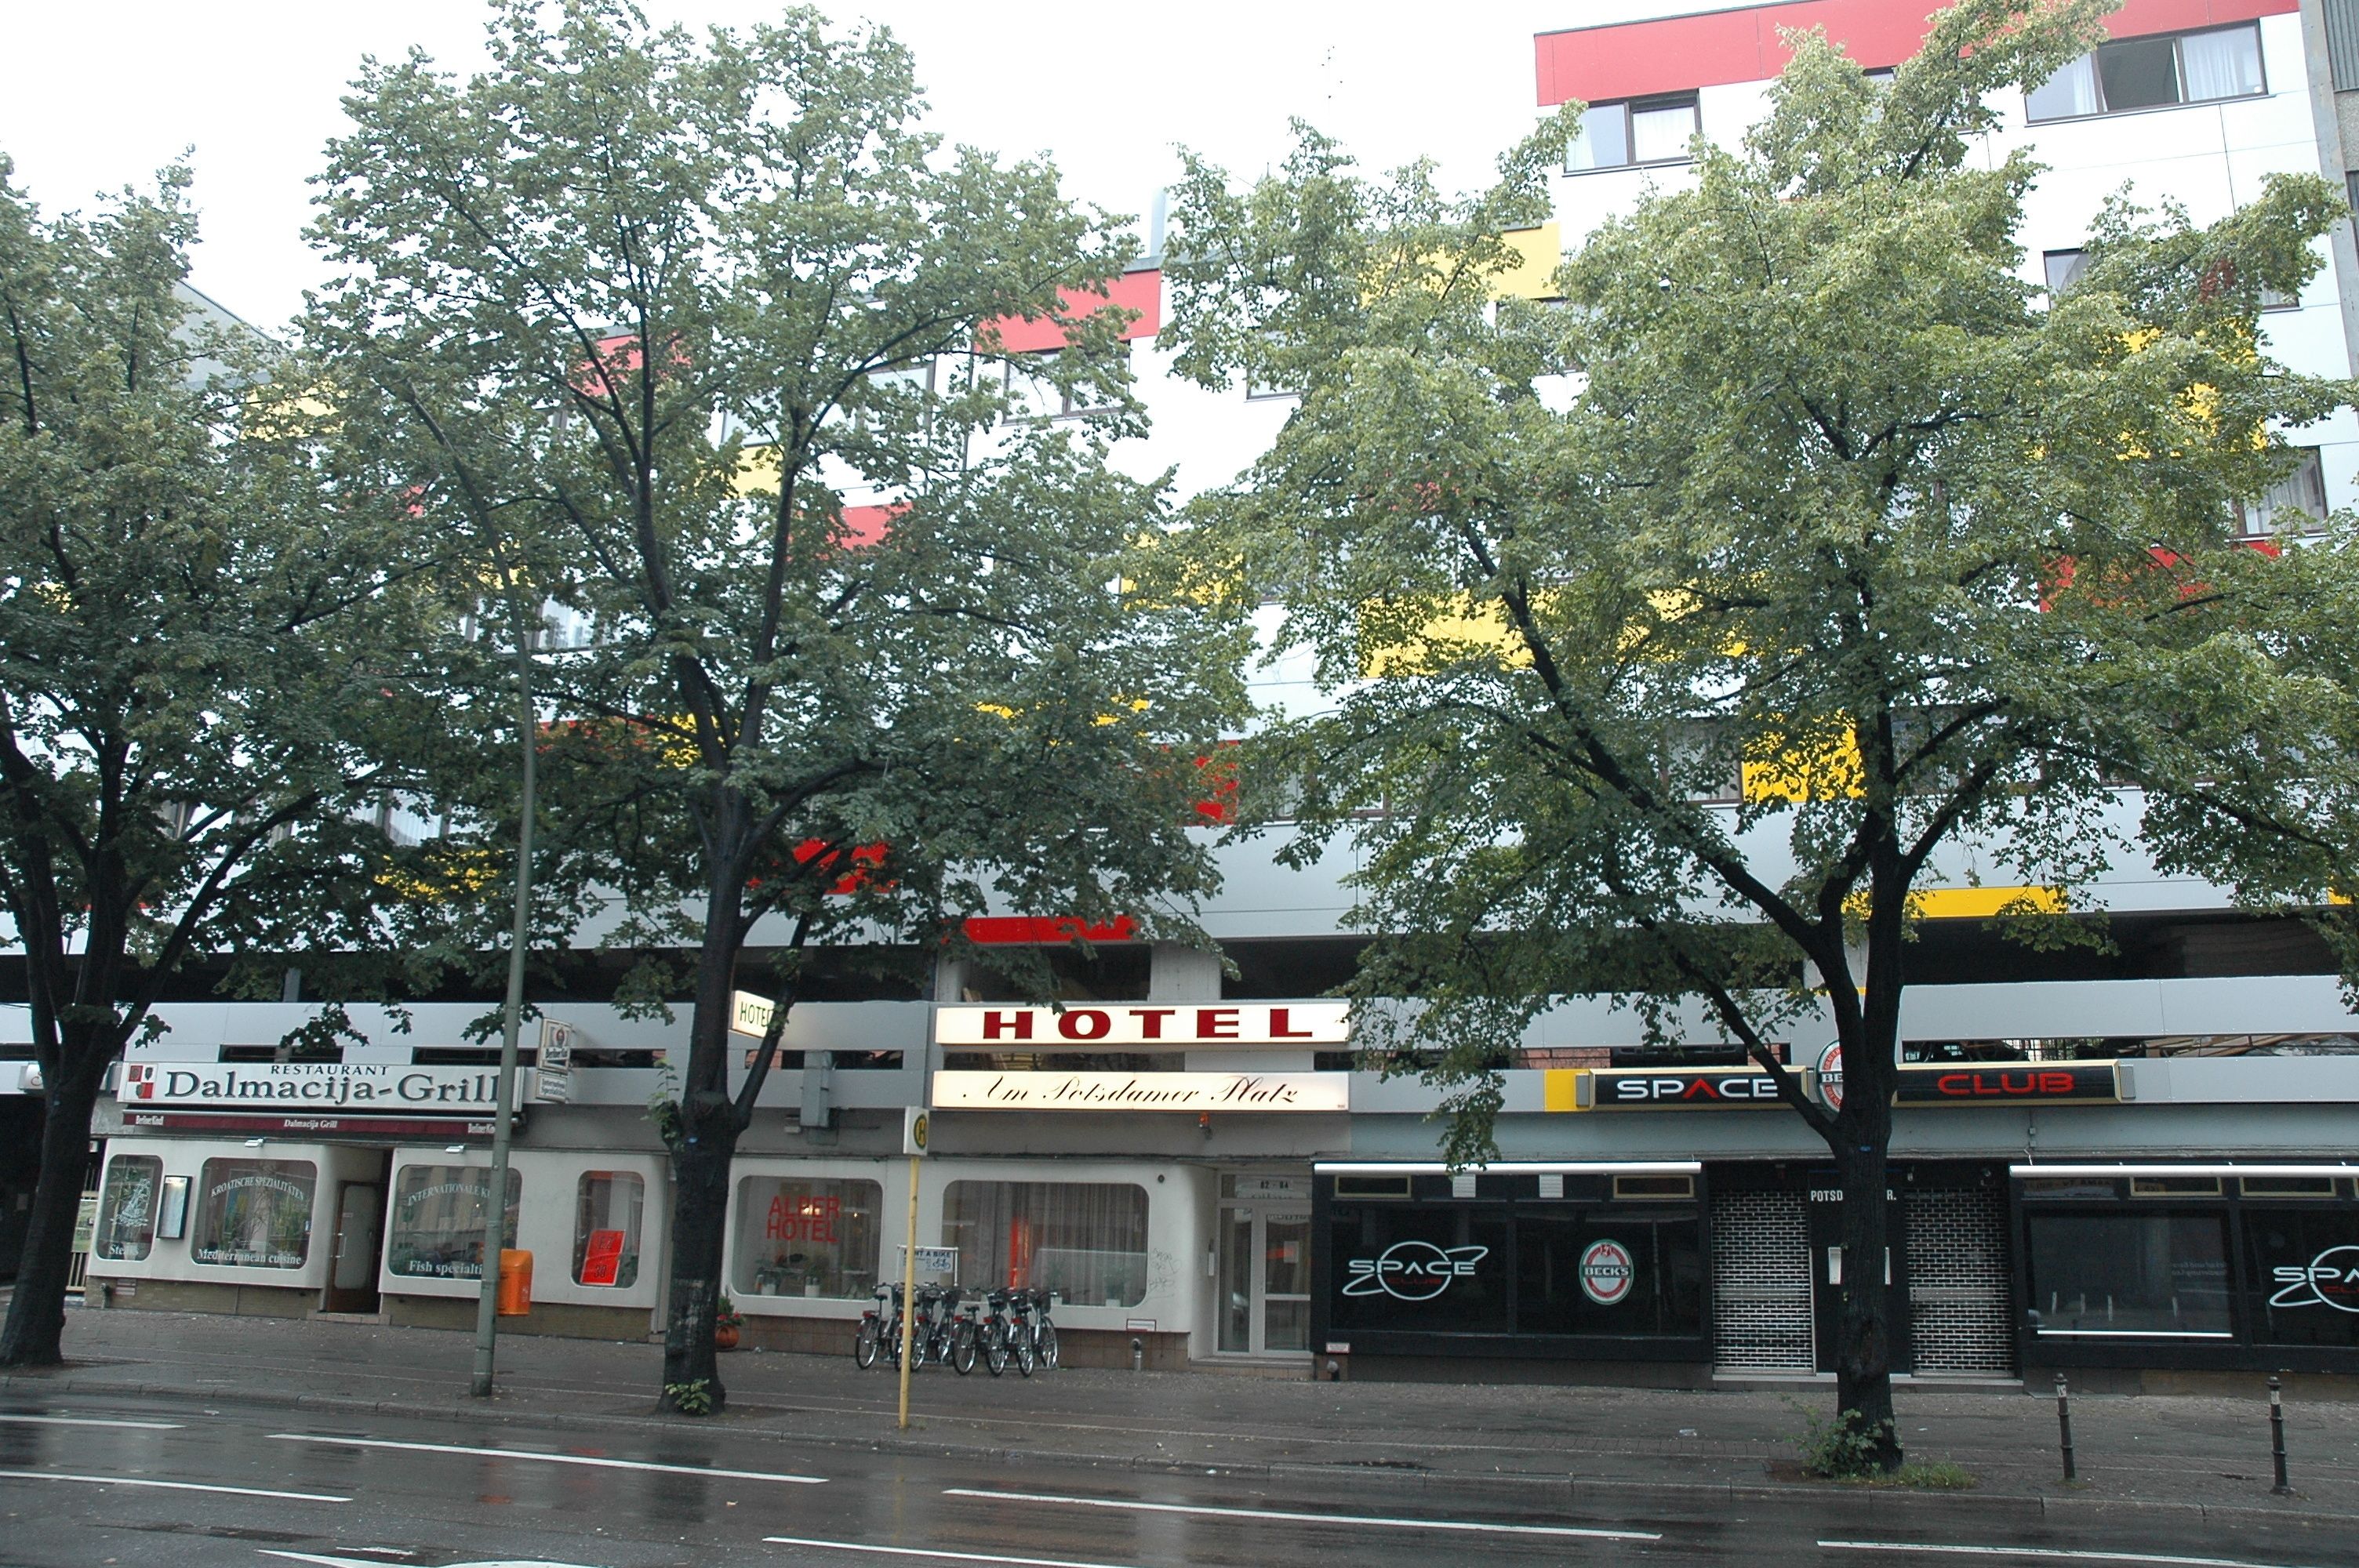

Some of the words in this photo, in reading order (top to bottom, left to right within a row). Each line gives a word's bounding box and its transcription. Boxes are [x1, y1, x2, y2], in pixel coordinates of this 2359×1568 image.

[740, 1001, 772, 1028] HOTEL
[982, 1008, 1313, 1040] HOTEL
[271, 1065, 389, 1075] RESTAURANT
[165, 1070, 500, 1105] Dalmacija-Grill
[963, 1074, 1028, 1102] Am
[1042, 1075, 1199, 1102] Potsdamer
[1210, 1075, 1299, 1103] Platz
[1617, 1078, 1779, 1098] SPACE
[1938, 1072, 2075, 1095] CLUB
[284, 1119, 318, 1130] Dalmacija
[320, 1120, 338, 1129] Grill
[211, 1176, 255, 1198] KROATISCHE
[408, 1182, 479, 1207] INTERNATIONALE
[766, 1218, 840, 1243] HOTEL
[109, 1243, 139, 1255] Stes
[198, 1248, 265, 1263] Mediterranean
[268, 1250, 302, 1265] cuisine
[409, 1260, 432, 1272] Fish
[435, 1262, 483, 1276] specialti
[1349, 1260, 1475, 1276] SPACE
[1584, 1267, 1629, 1276] BECK'S
[2274, 1267, 2359, 1283] SPA
